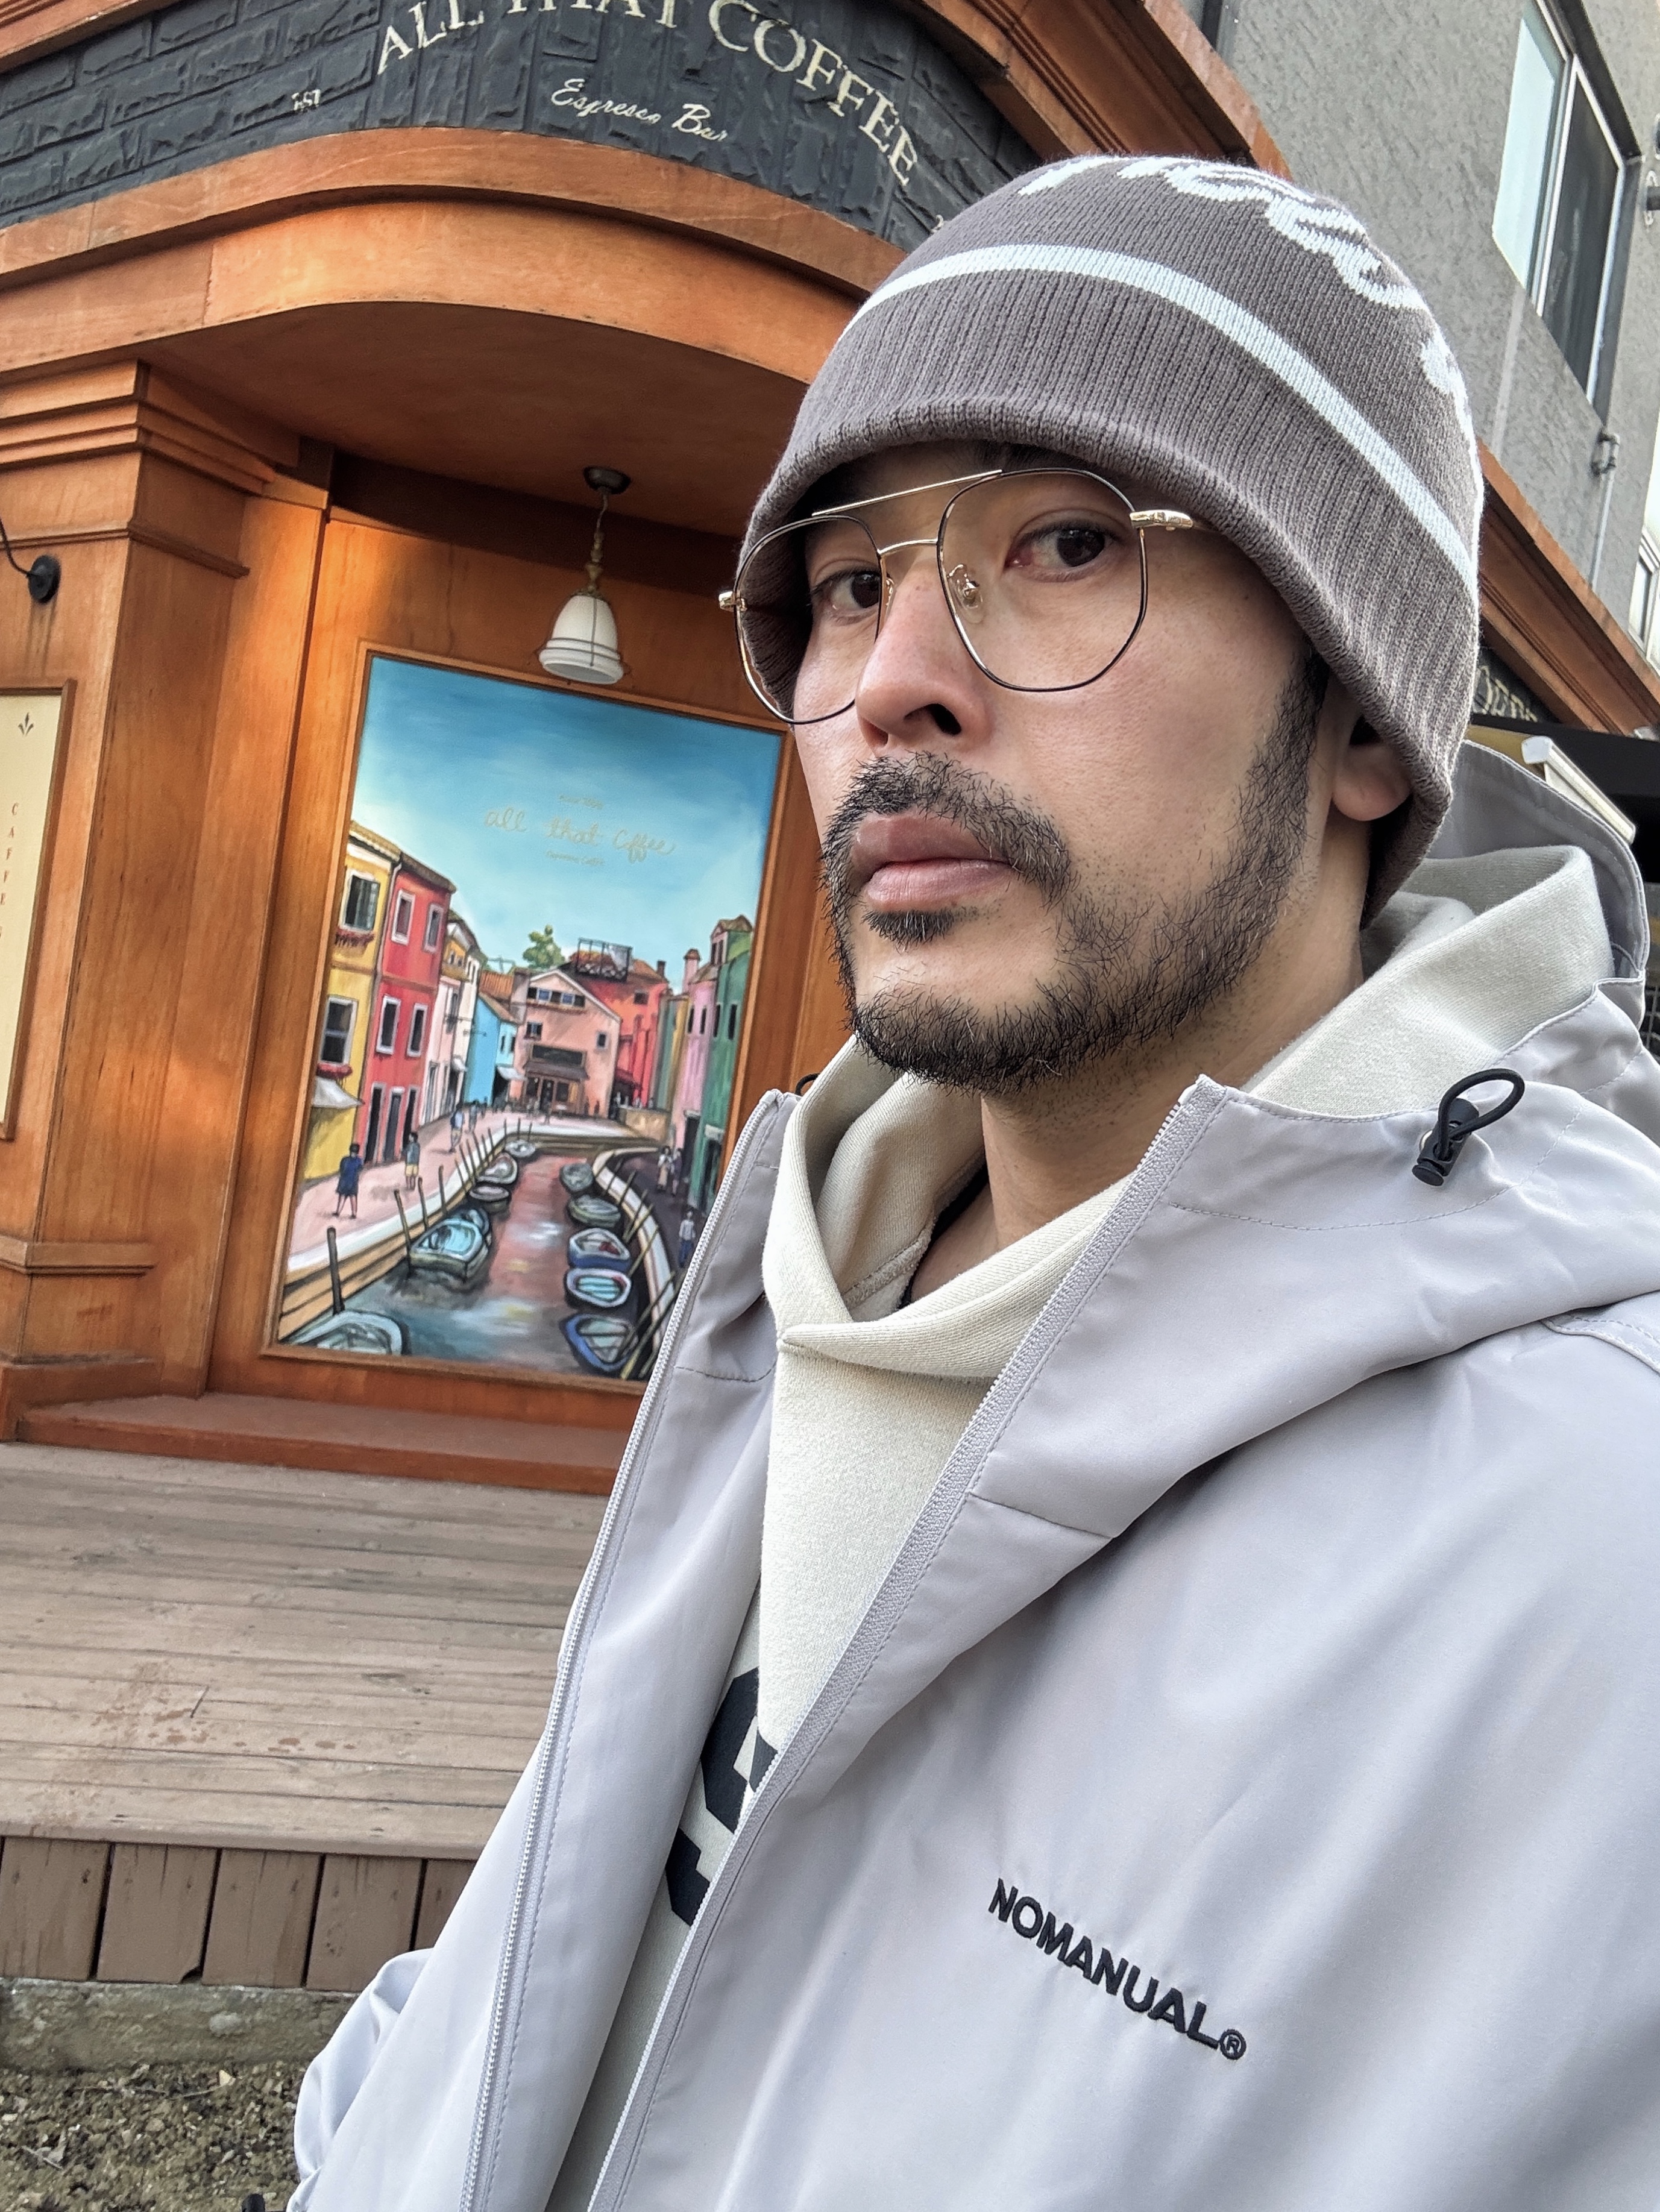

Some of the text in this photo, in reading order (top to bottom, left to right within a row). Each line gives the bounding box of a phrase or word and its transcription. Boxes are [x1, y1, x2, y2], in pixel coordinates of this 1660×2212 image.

[377, 0, 919, 186] ALL COFFEE
[671, 103, 728, 142] Bar
[483, 806, 527, 832] all
